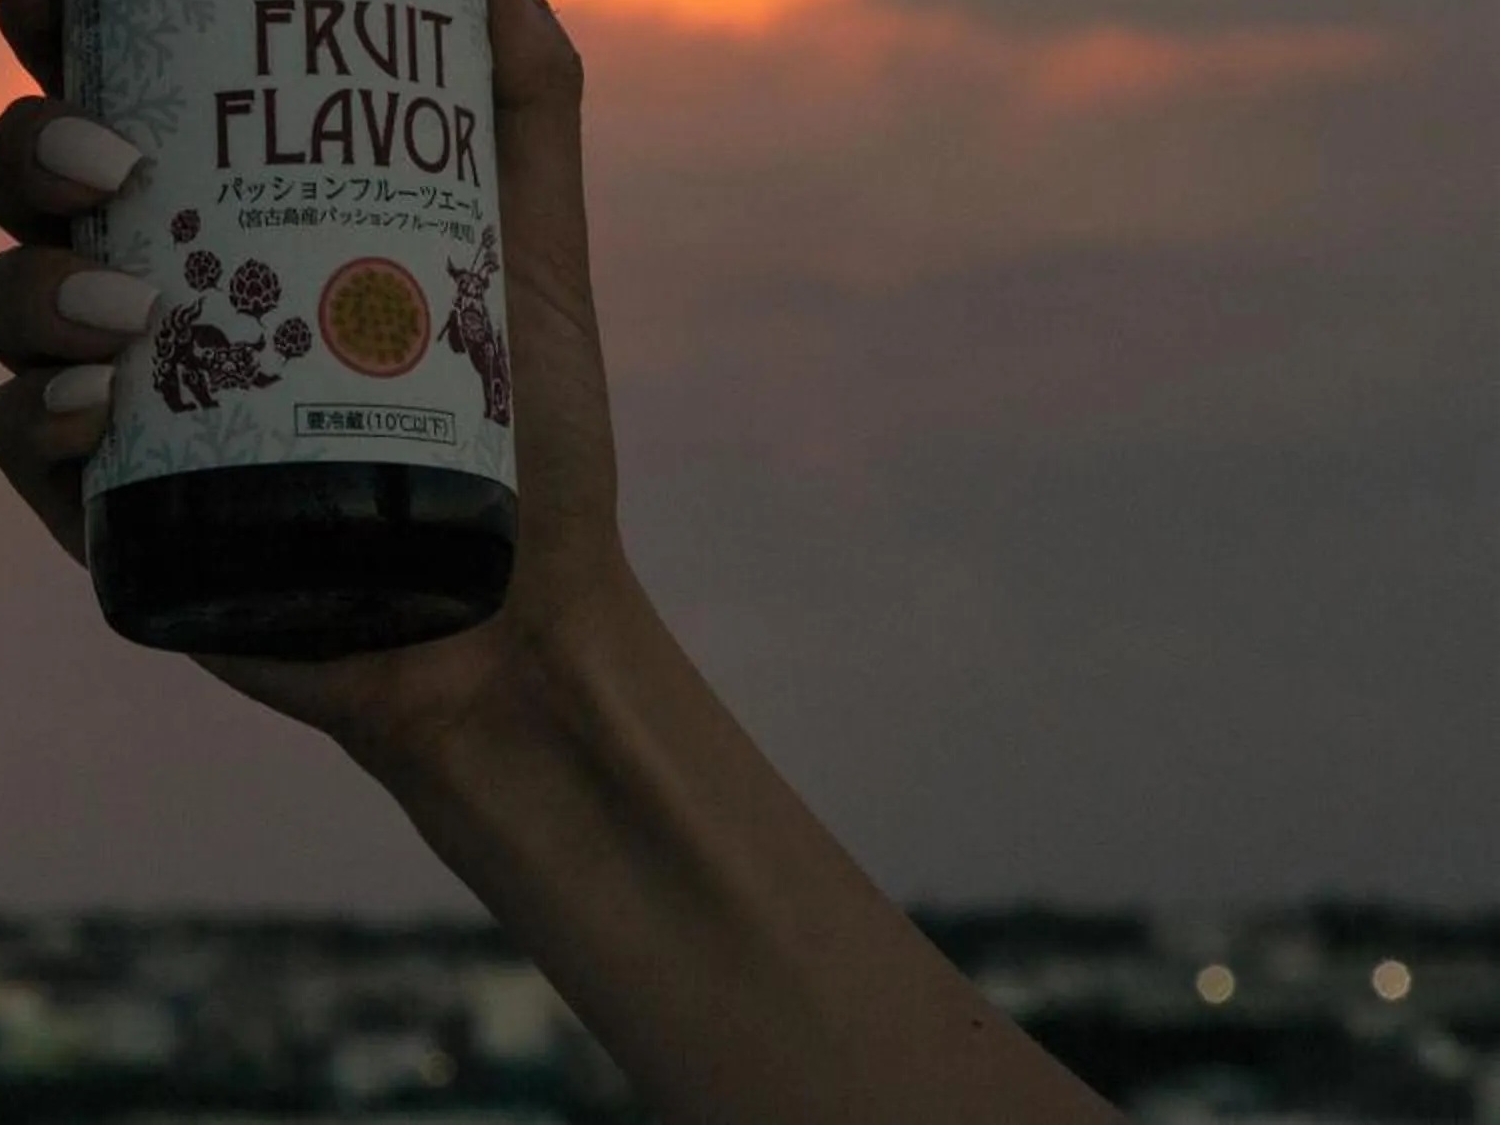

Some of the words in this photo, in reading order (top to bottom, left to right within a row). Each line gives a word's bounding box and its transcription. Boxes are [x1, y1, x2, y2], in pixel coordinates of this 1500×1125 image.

[214, 88, 481, 187] FLAVOR
[217, 175, 485, 221] パッションフルーツエール
